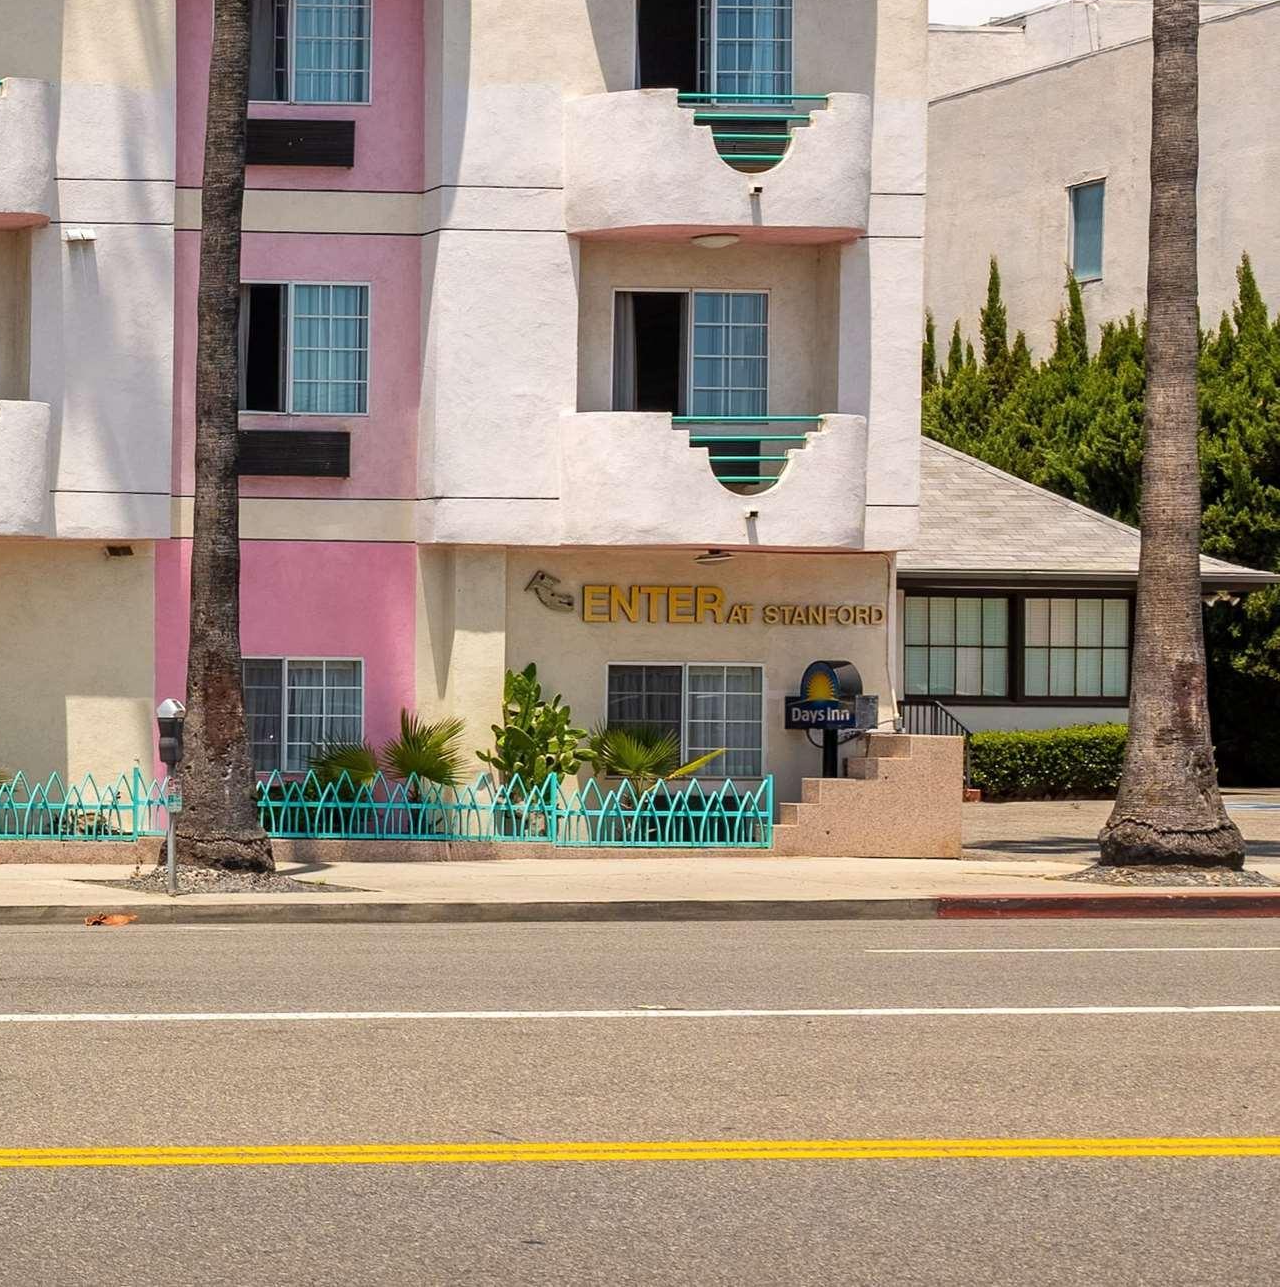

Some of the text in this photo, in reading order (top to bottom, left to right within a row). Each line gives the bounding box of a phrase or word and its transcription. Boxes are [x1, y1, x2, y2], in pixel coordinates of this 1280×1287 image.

[582, 585, 886, 626] ENTER AT STANFORD
[791, 706, 850, 723] Days Inn
